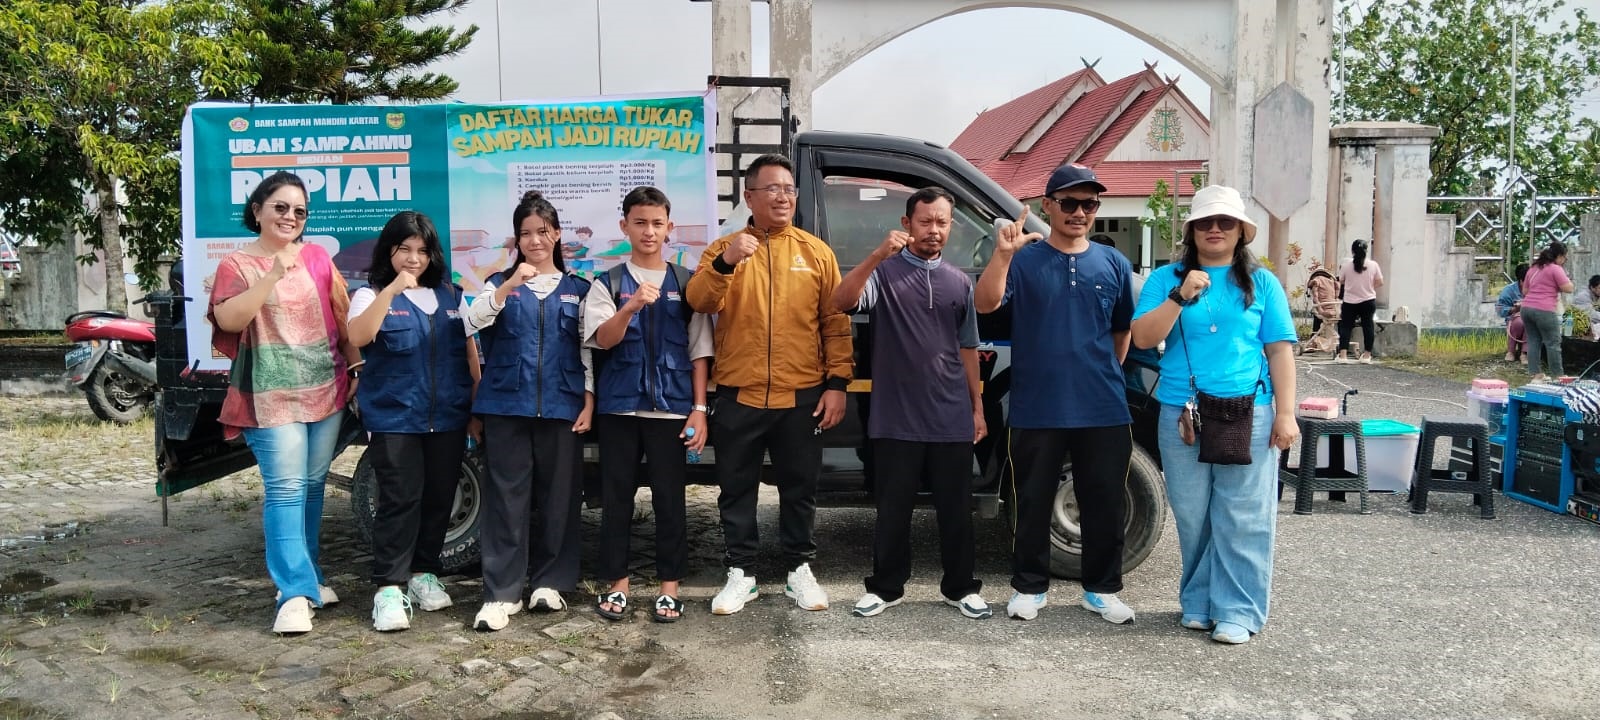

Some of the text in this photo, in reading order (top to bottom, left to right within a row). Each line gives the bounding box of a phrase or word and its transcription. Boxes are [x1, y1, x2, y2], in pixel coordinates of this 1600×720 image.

[254, 116, 380, 128] BANK SAMPAH MANDIRI KARTAR
[459, 106, 694, 132] DAFTAR HARGA TUKAR
[229, 135, 413, 154] UBAH SAMPAHMU
[453, 126, 703, 158] SAMPAH JADI RUPIAH
[231, 166, 412, 205] RPIAH
[306, 225, 336, 233] Rupiah
